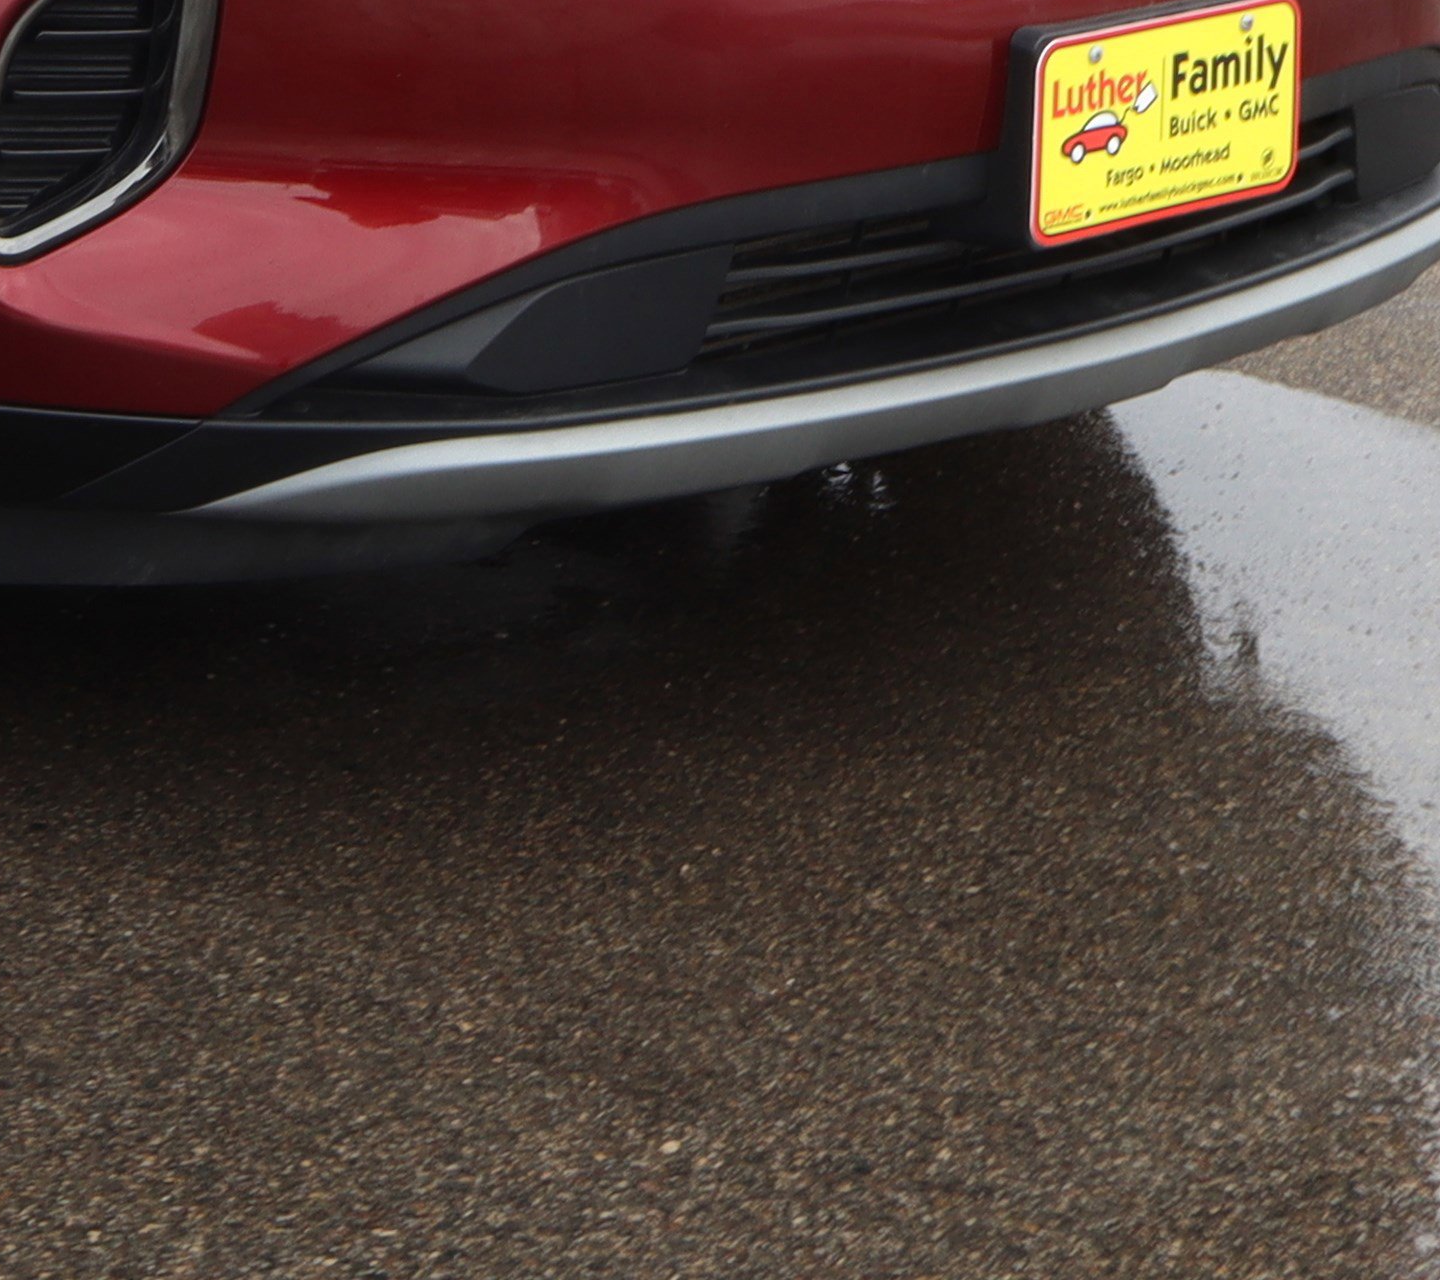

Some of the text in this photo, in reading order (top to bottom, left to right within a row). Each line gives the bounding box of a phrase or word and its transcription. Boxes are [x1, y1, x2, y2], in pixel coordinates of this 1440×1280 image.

[1170, 33, 1289, 101] Family
[1052, 66, 1149, 121] Luther
[1169, 94, 1280, 139] Buick GMC
[1105, 166, 1145, 189] Fargo
[1159, 143, 1231, 176] Moorhead
[1043, 203, 1084, 227] GMC
